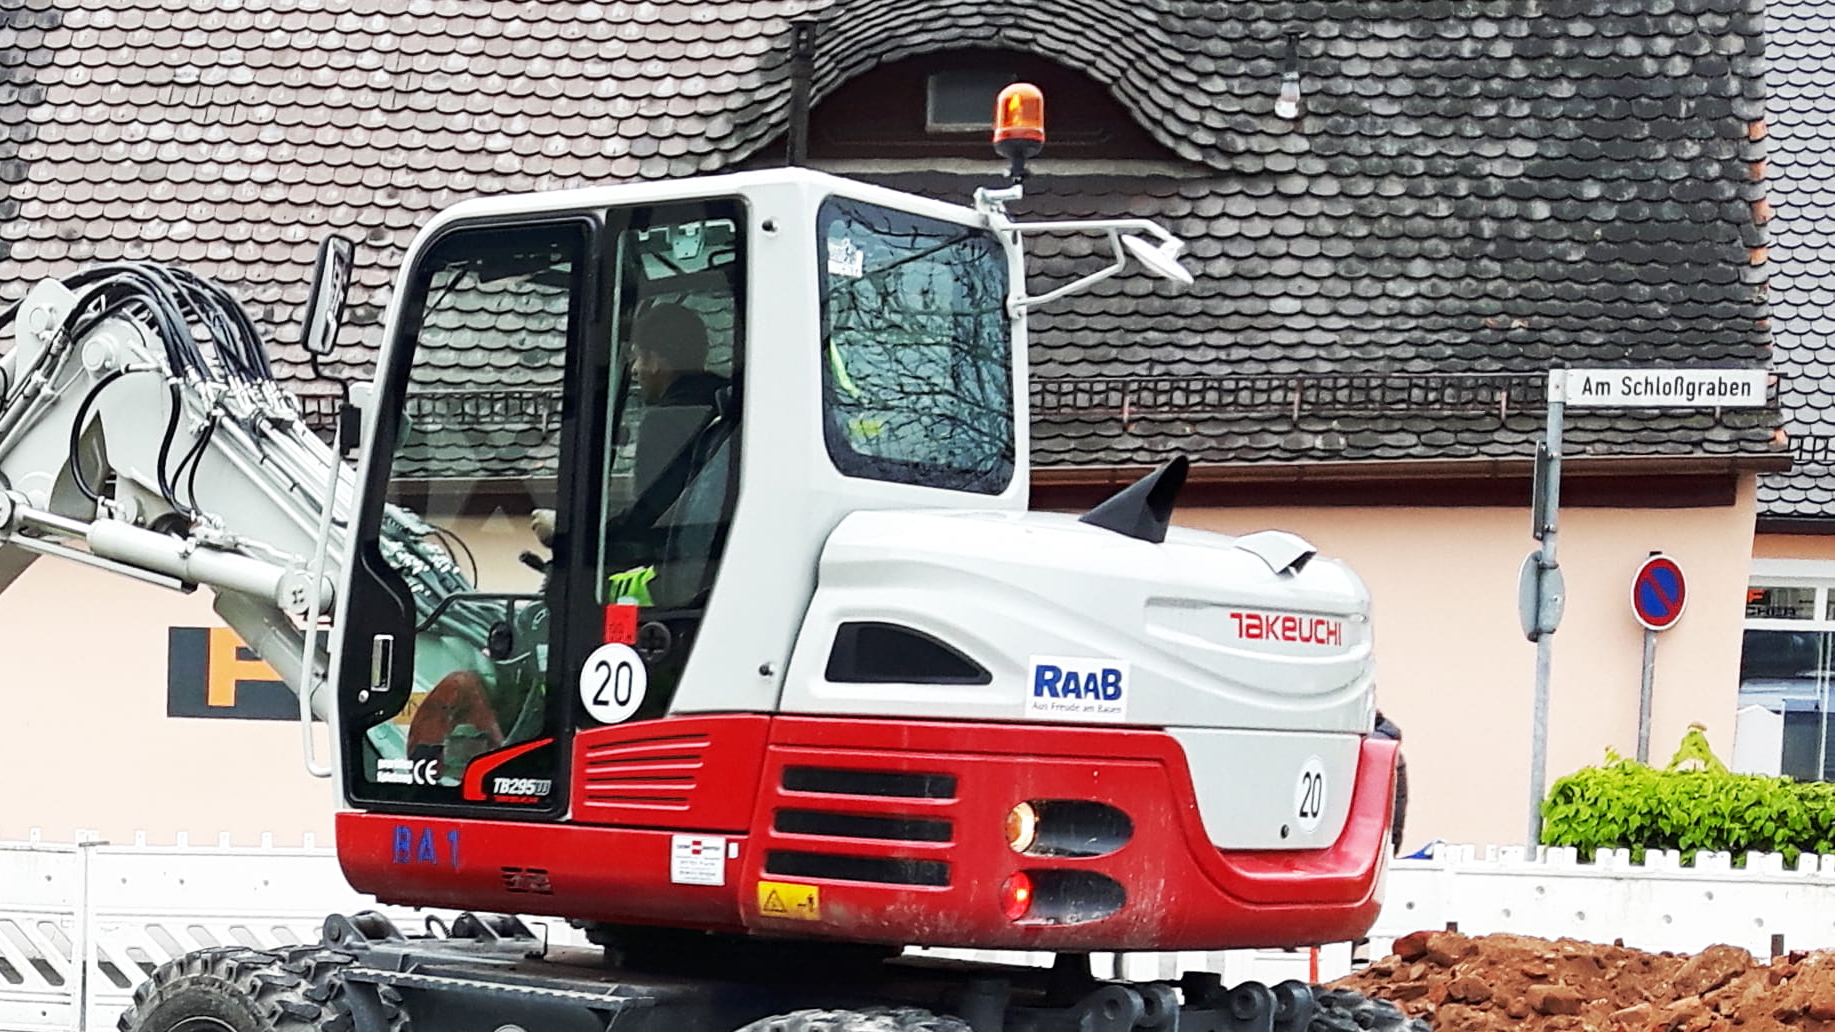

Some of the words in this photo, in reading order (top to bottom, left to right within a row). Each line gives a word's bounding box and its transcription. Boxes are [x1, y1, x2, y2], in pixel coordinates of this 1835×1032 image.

[1581, 376, 1611, 397] Am
[1621, 375, 1752, 402] Schloßgraben
[592, 659, 633, 707] 20
[1298, 770, 1323, 819] 20
